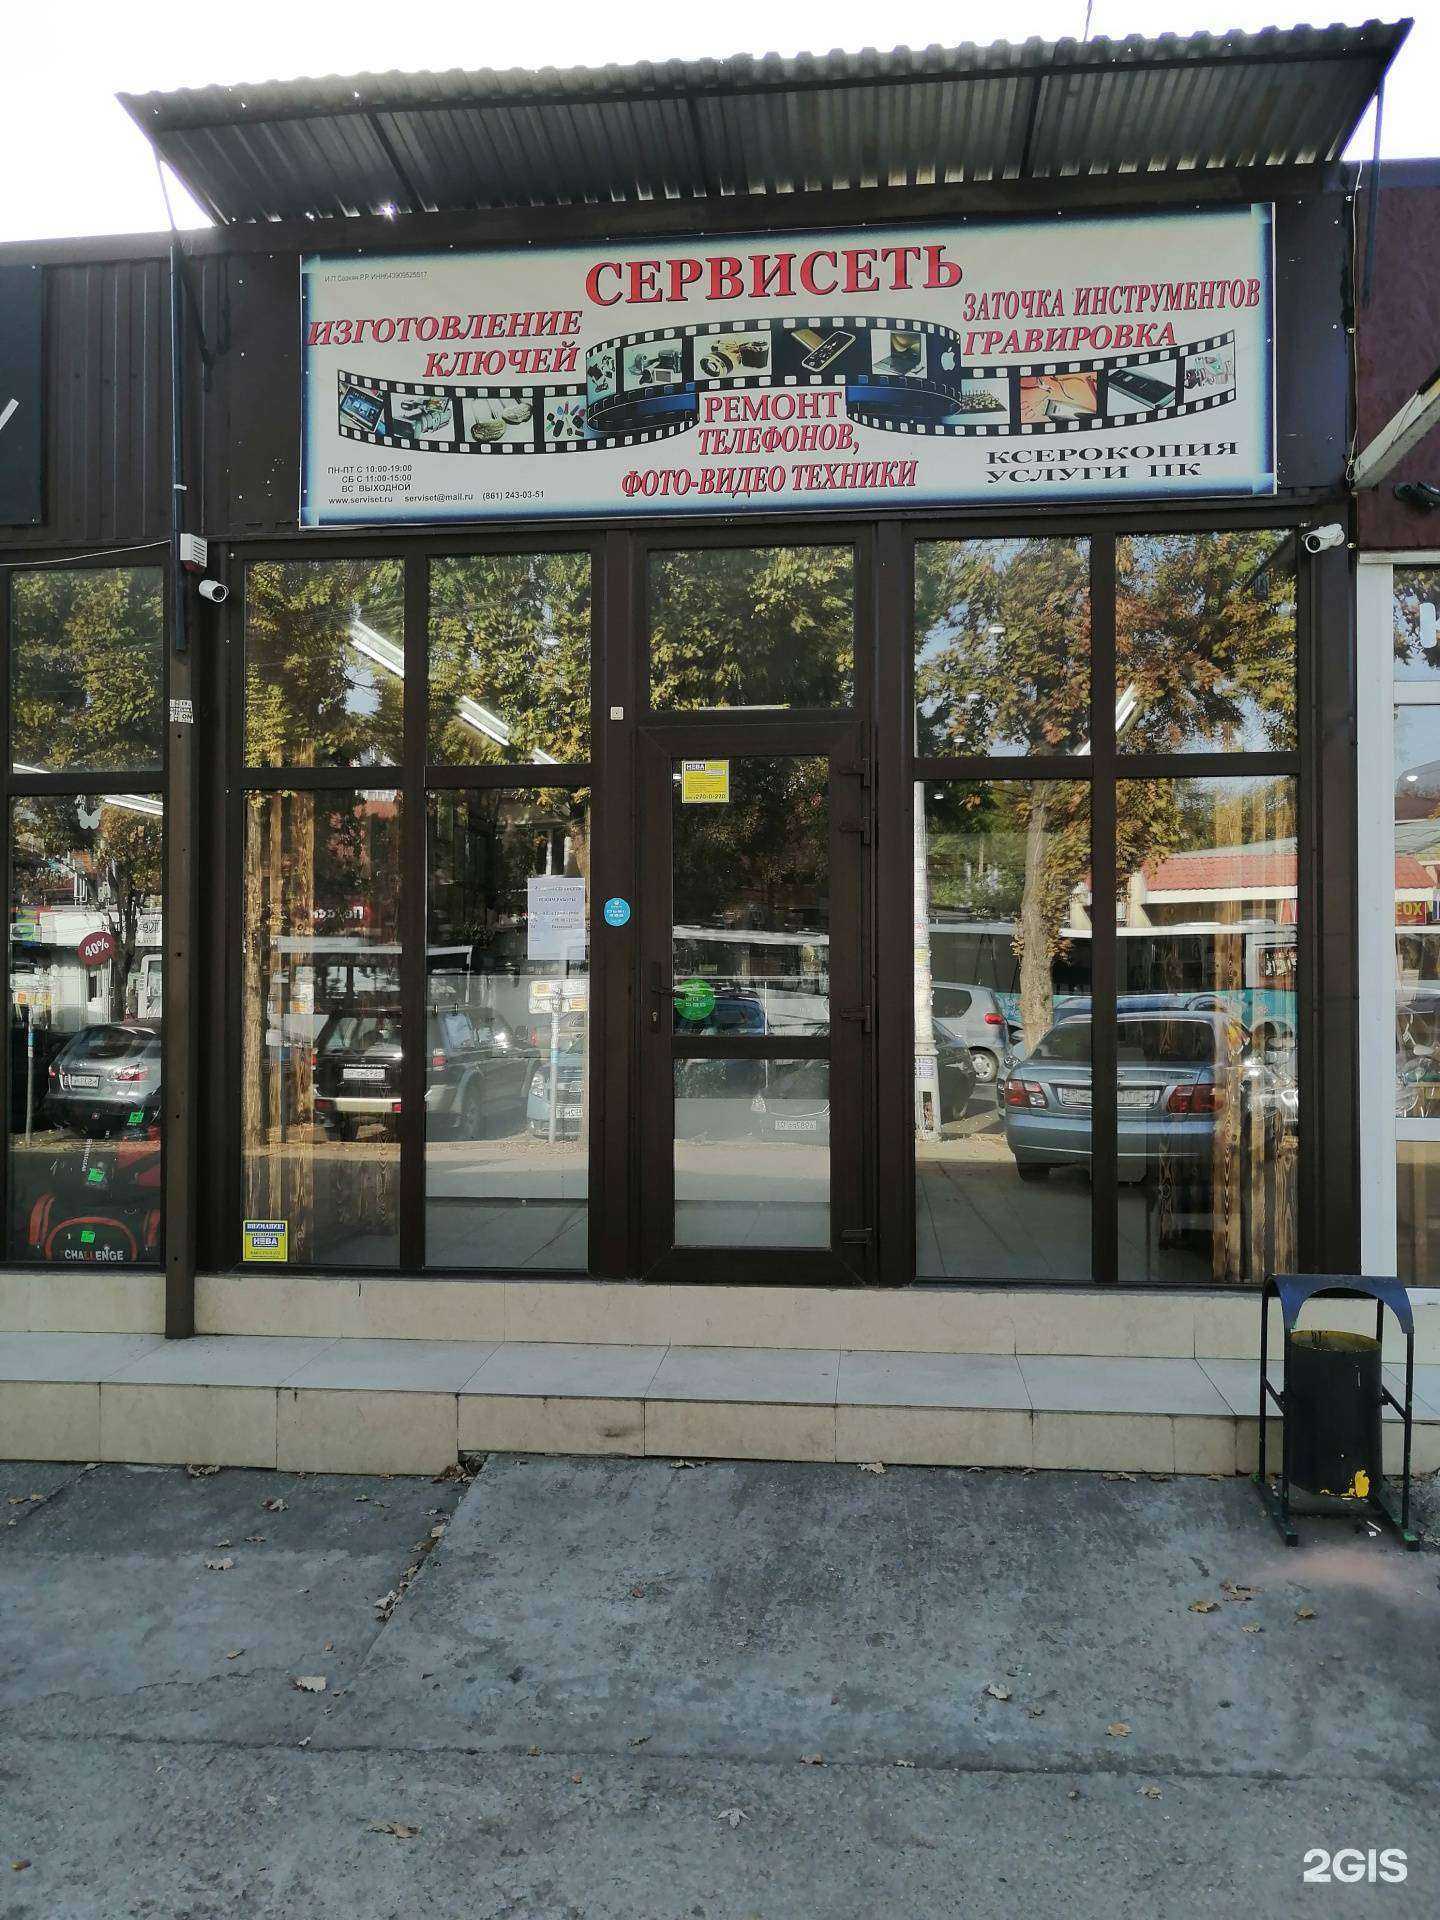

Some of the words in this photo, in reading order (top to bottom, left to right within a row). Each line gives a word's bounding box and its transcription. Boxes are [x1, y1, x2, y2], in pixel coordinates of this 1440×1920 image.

[585, 245, 963, 306] СЕРВИСЕТЬ
[962, 288, 1064, 321] ЗАТОЧКА
[1073, 278, 1260, 316] ИНСТРУМЕНТОВ
[306, 310, 583, 346] ИЗГОТОВЛЕНИЕ
[963, 322, 1177, 356] ГРАВИРОВКА
[422, 340, 580, 377] КЛЮЧЕЙ
[704, 392, 843, 423] РЕМОНТ
[698, 423, 860, 455] ТЕЛЕФОНОВ,
[986, 441, 1240, 465] КСЕРОКОПИЯ
[328, 466, 354, 475] ПН-ПТ
[365, 464, 412, 473] 10:00-19:00
[366, 474, 412, 482] 11:00-15:00
[621, 465, 787, 498] ФОТО-ВИДЕО
[792, 460, 919, 490] ТЕХНИКИ
[986, 465, 1129, 484] УСЛУГИ
[1148, 462, 1202, 478] ПК
[328, 495, 393, 504] www.serviset.ru
[404, 493, 474, 503] serviset@mail.ru
[482, 491, 503, 500] (861)
[505, 490, 545, 499] 243-03-51
[341, 485, 354, 493] ВС
[358, 483, 411, 493] ВЫХОДНОЙ
[84, 938, 110, 957] 40%
